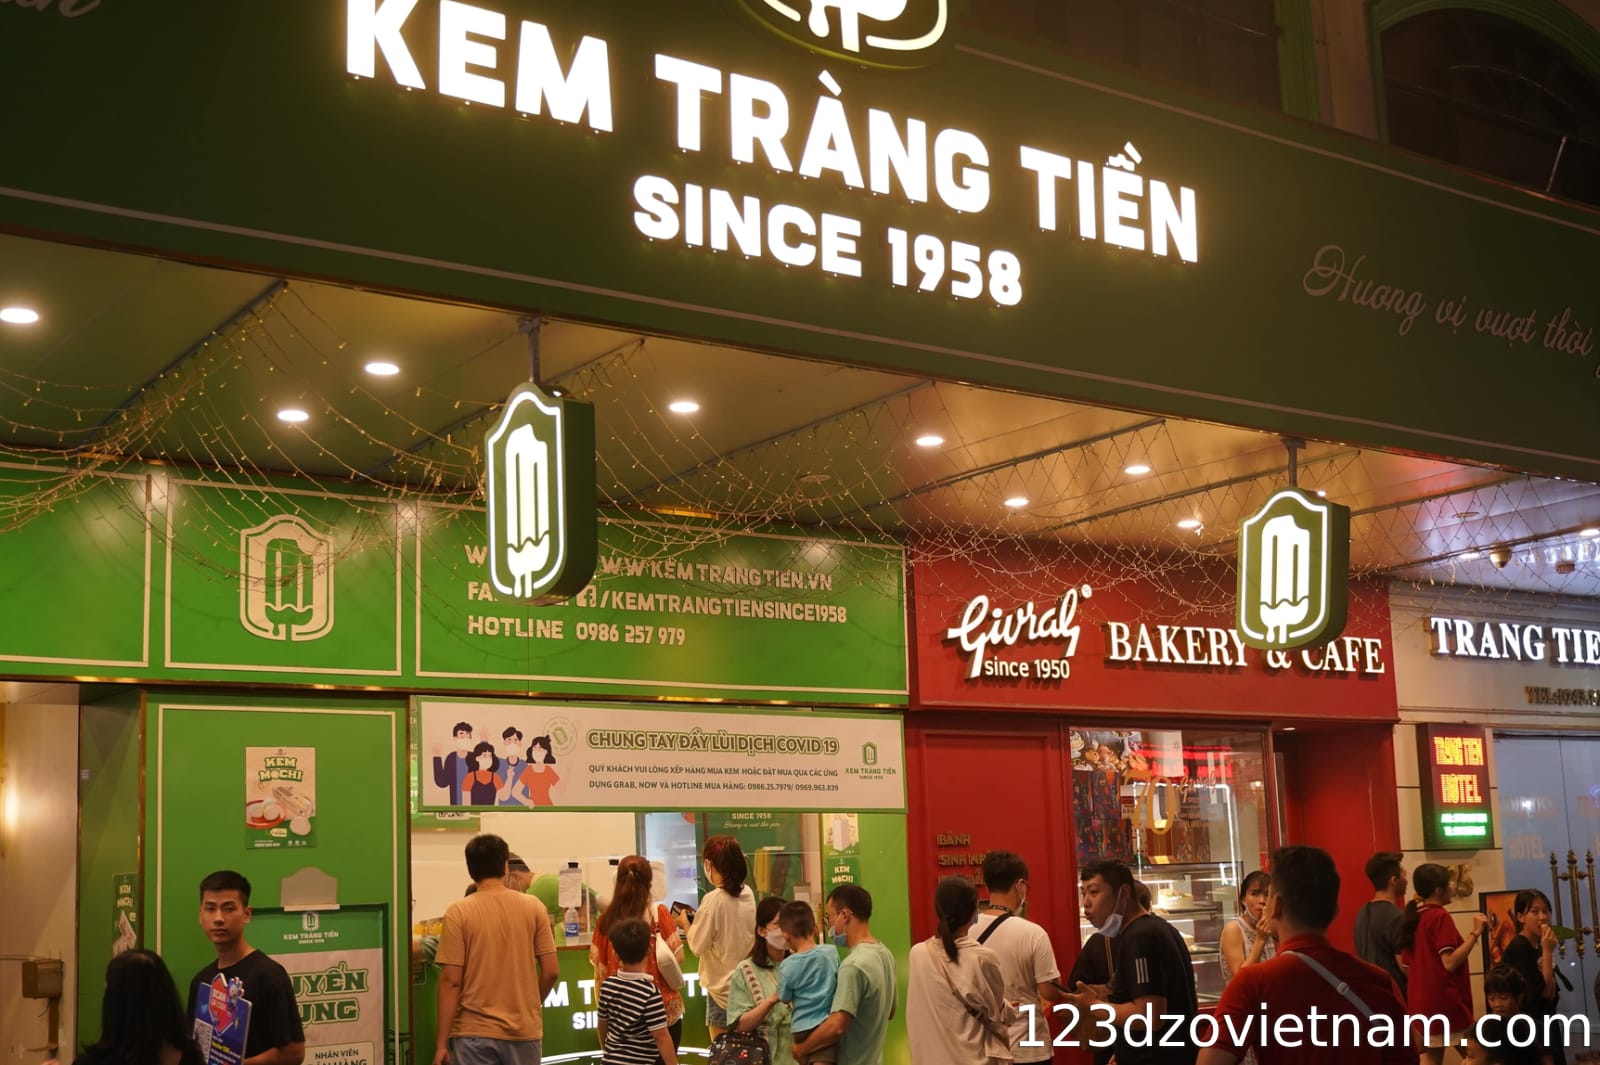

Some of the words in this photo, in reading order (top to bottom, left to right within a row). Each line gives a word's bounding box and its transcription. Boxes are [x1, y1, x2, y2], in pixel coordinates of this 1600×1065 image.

[347, 0, 613, 132] KEM
[655, 53, 990, 213] TRÀNG
[1020, 141, 1198, 263] TIỀN
[633, 174, 862, 277] SINCE
[887, 227, 1022, 306] 1958
[1436, 296, 1467, 335] vị
[468, 615, 564, 639] HOTLINE
[576, 622, 619, 641] 0986
[624, 625, 654, 643] 257
[658, 627, 685, 645] 979
[947, 587, 1080, 677] Givral
[1431, 617, 1545, 660] TRANG
[1552, 628, 1600, 664] TIE
[1107, 621, 1248, 666] BAKERY
[1302, 638, 1385, 673] CAFE
[984, 656, 1029, 676] since
[1034, 659, 1070, 678] 1950
[588, 731, 646, 748] CHUNG
[647, 732, 677, 749] TAY
[711, 731, 736, 750] LÙI
[738, 736, 774, 754] DỊCH
[776, 737, 822, 753] COVID
[823, 739, 838, 753] 19
[265, 757, 297, 769] KEM
[707, 767, 723, 775] MUA
[725, 768, 739, 776] KEM
[794, 769, 809, 778] QUA
[613, 781, 637, 790] GRAB,
[639, 781, 657, 789] NOW
[671, 782, 704, 790] HOTLINE
[704, 782, 721, 790] MUA
[1440, 774, 1482, 803] HOTEL
[290, 960, 369, 997] UYỂN
[298, 998, 360, 1030] ỤNG
